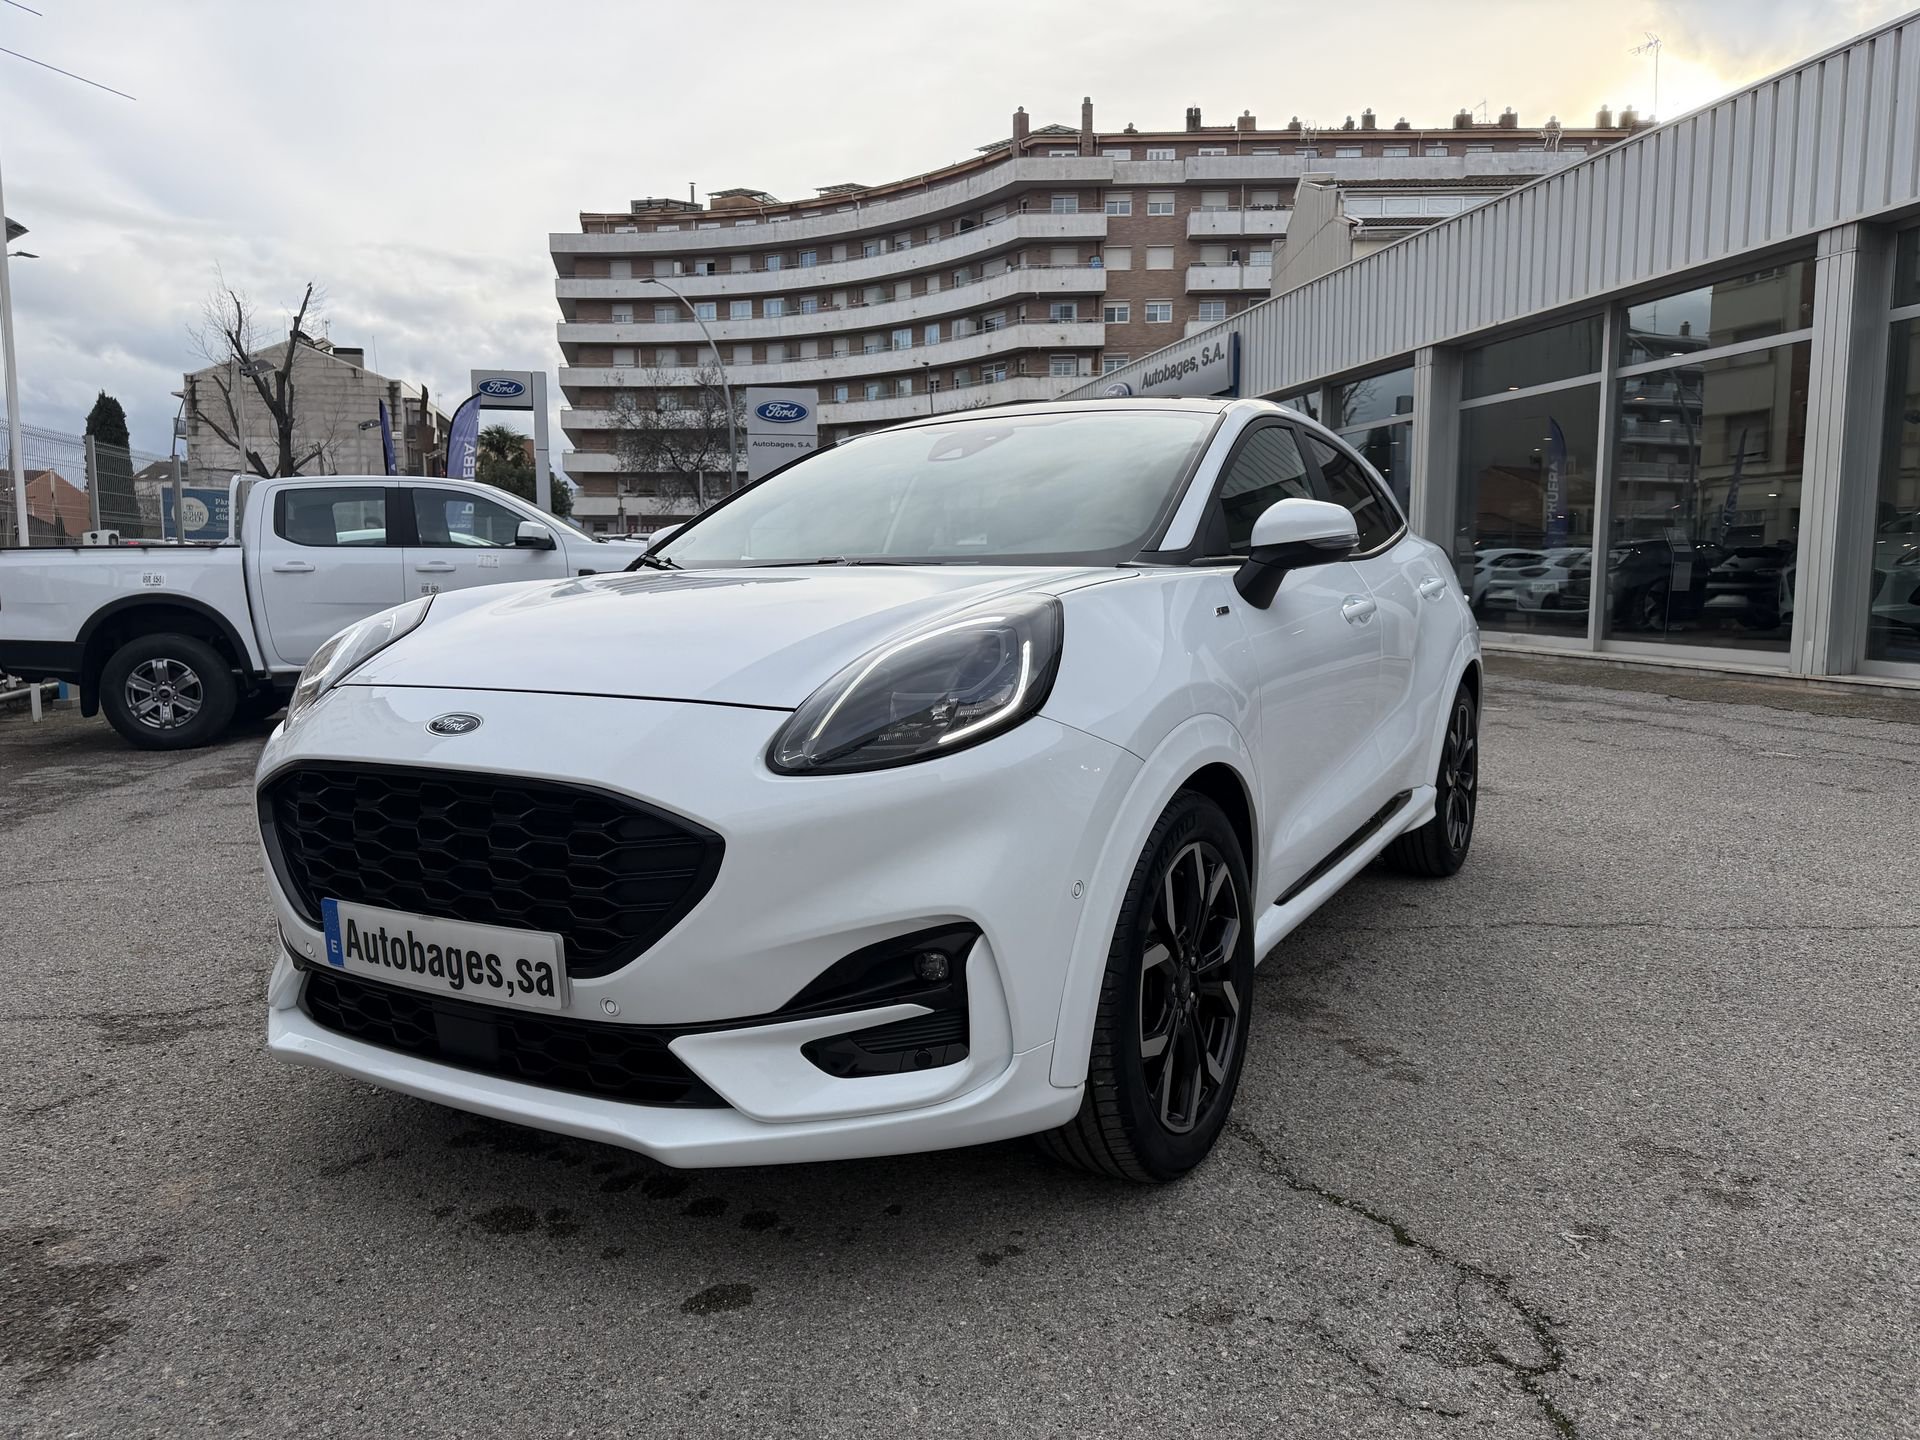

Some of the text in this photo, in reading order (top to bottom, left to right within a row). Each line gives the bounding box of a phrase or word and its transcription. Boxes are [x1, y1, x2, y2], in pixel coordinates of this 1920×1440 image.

[1141, 342, 1225, 390] Autobages, S.A.
[486, 382, 516, 393] Ford
[766, 404, 798, 417] Ford
[436, 717, 470, 730] Ford
[331, 919, 555, 998] E Autobages,sa
